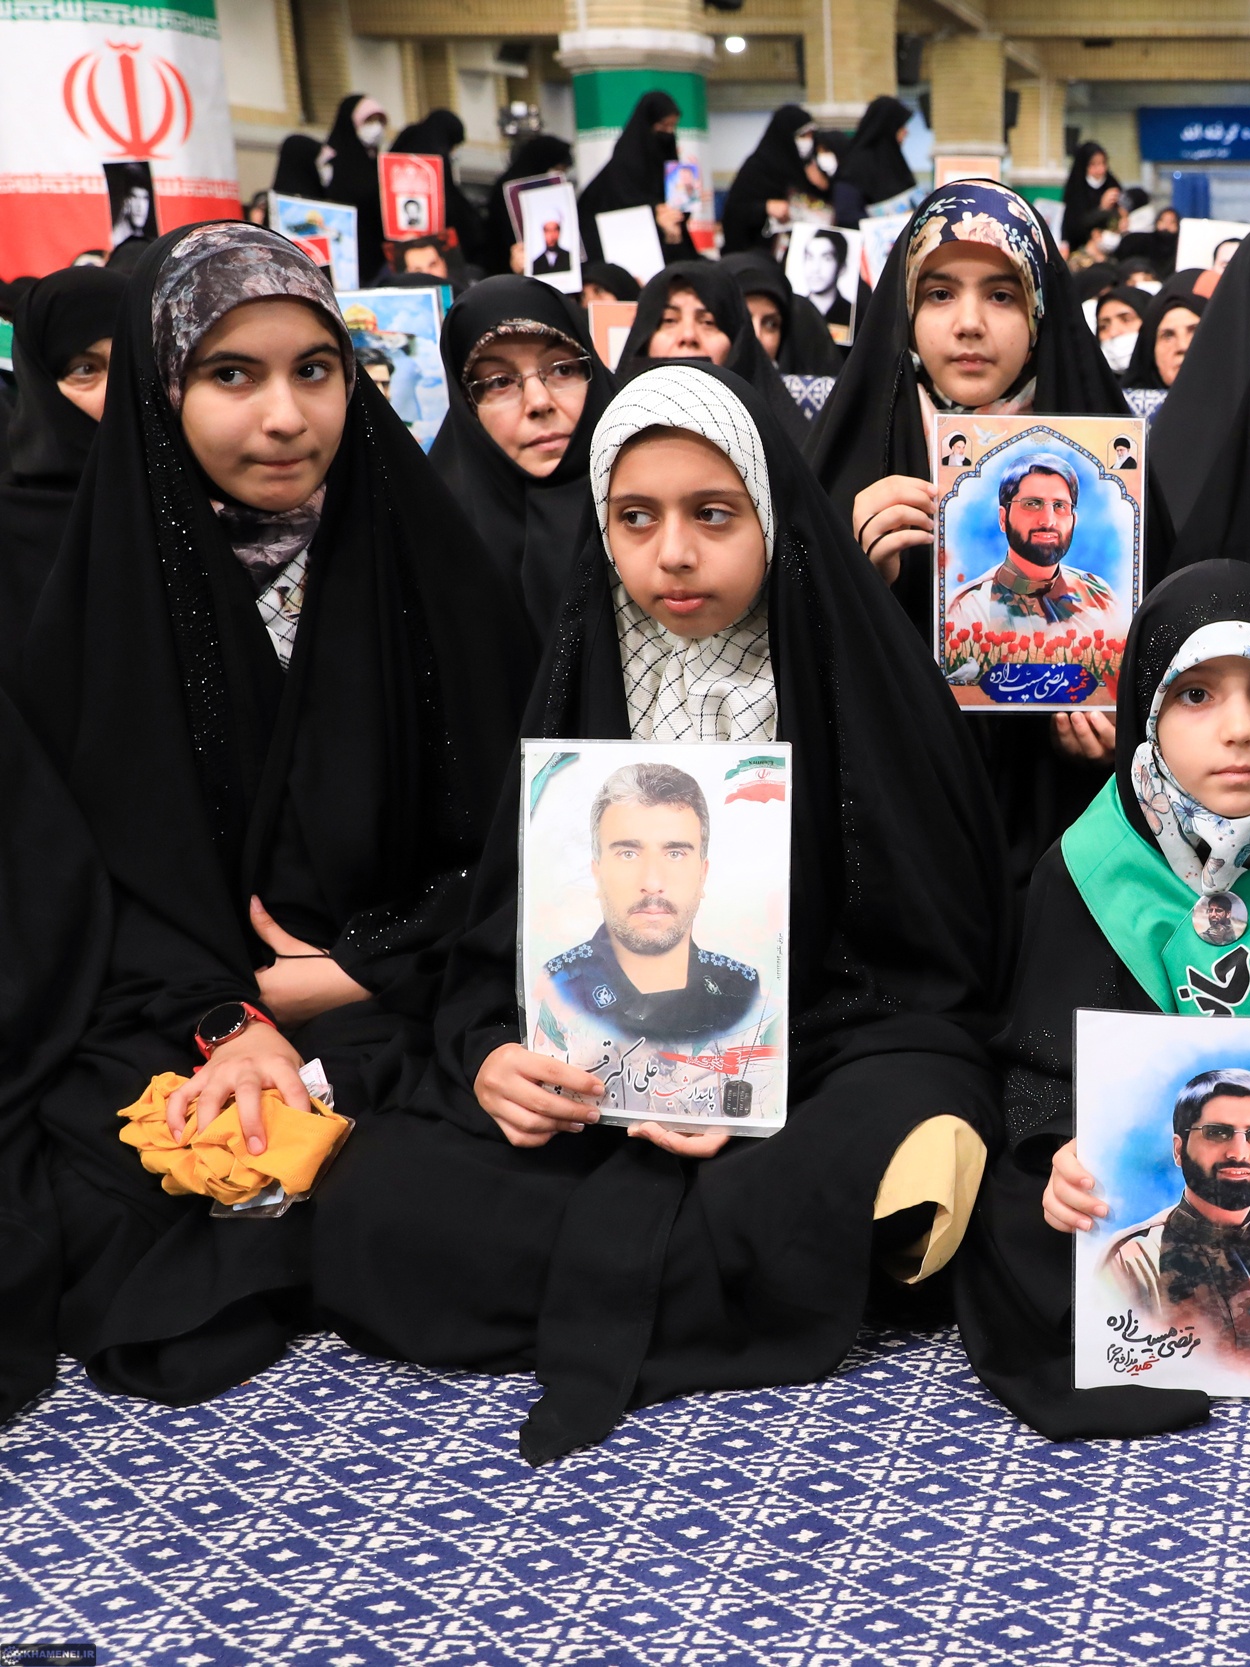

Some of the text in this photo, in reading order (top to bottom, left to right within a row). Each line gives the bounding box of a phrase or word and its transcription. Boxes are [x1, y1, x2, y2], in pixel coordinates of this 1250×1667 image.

[1034, 662, 1070, 699] مرتضی
[1066, 668, 1090, 703] شهید
[604, 1038, 646, 1099] اکبر
[634, 1060, 659, 1094] علی
[652, 1075, 689, 1106] شهید
[688, 1085, 715, 1111] پاسدار
[1159, 1326, 1201, 1358] مرتضی
[1113, 1348, 1139, 1373] مدافع
[1127, 1353, 1160, 1377] شهید
